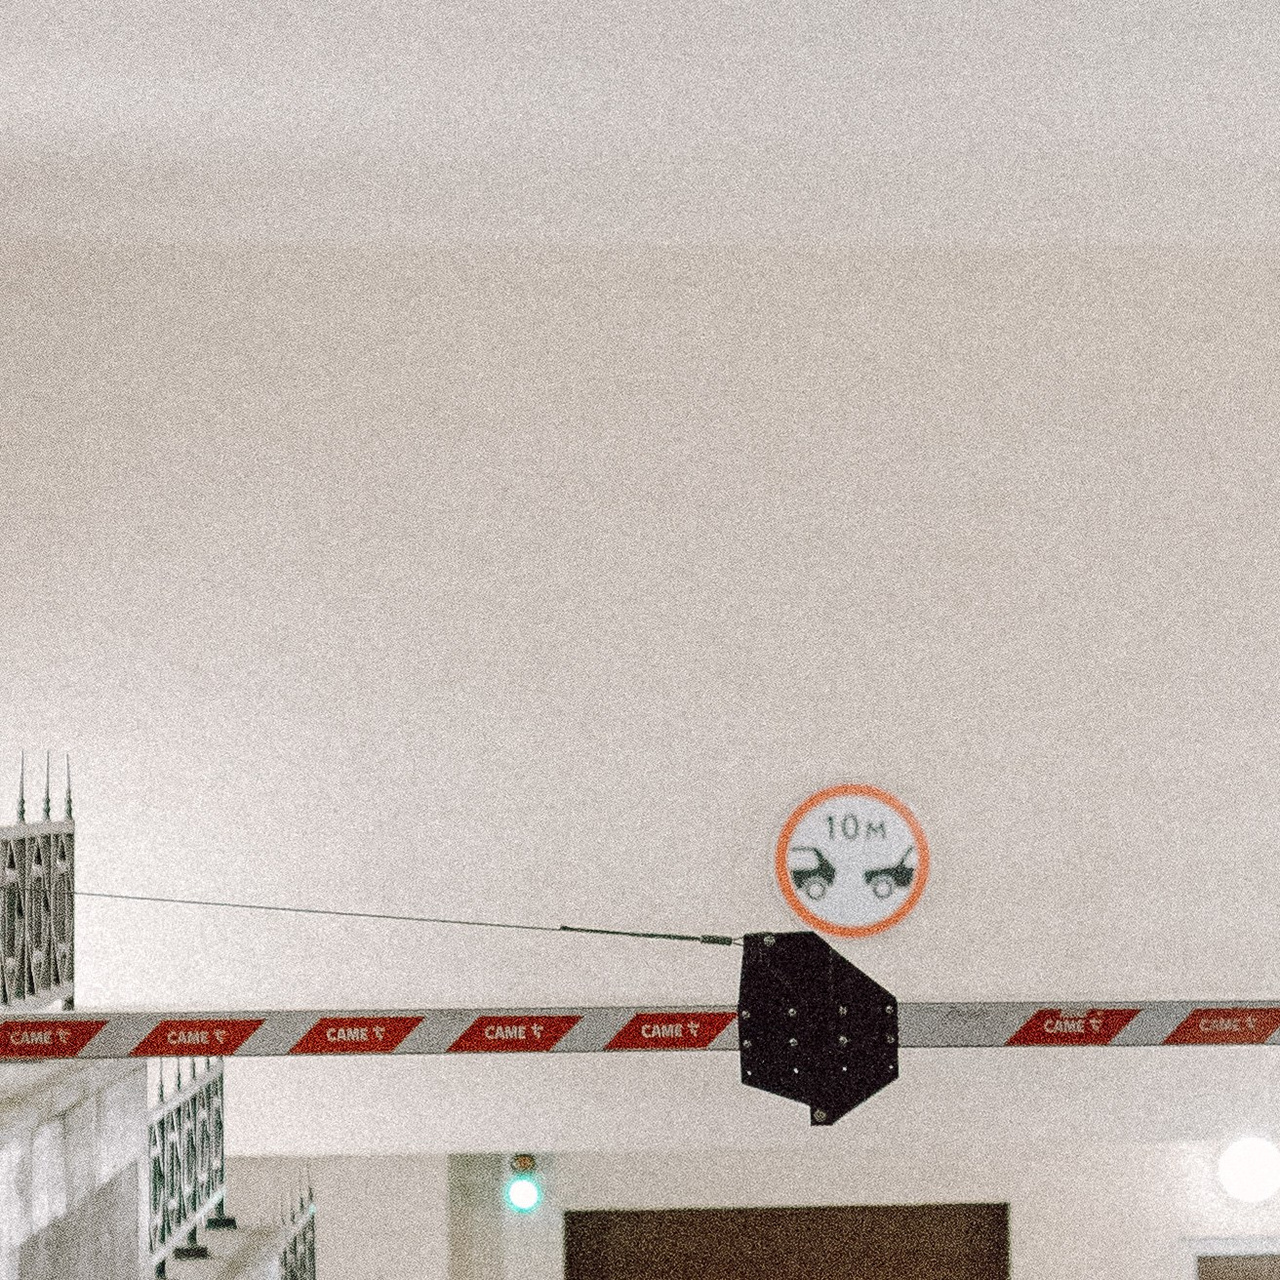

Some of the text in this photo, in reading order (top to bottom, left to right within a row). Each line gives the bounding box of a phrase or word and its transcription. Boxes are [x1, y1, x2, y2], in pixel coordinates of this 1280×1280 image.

[641, 1023, 683, 1038] CAME
[1044, 1019, 1085, 1033] CAME
[1199, 1017, 1241, 1032] CAME
[10, 1030, 53, 1044] CAME
[167, 1030, 210, 1045] CAME
[326, 1027, 368, 1041] CAME
[485, 1025, 525, 1039] CAME
